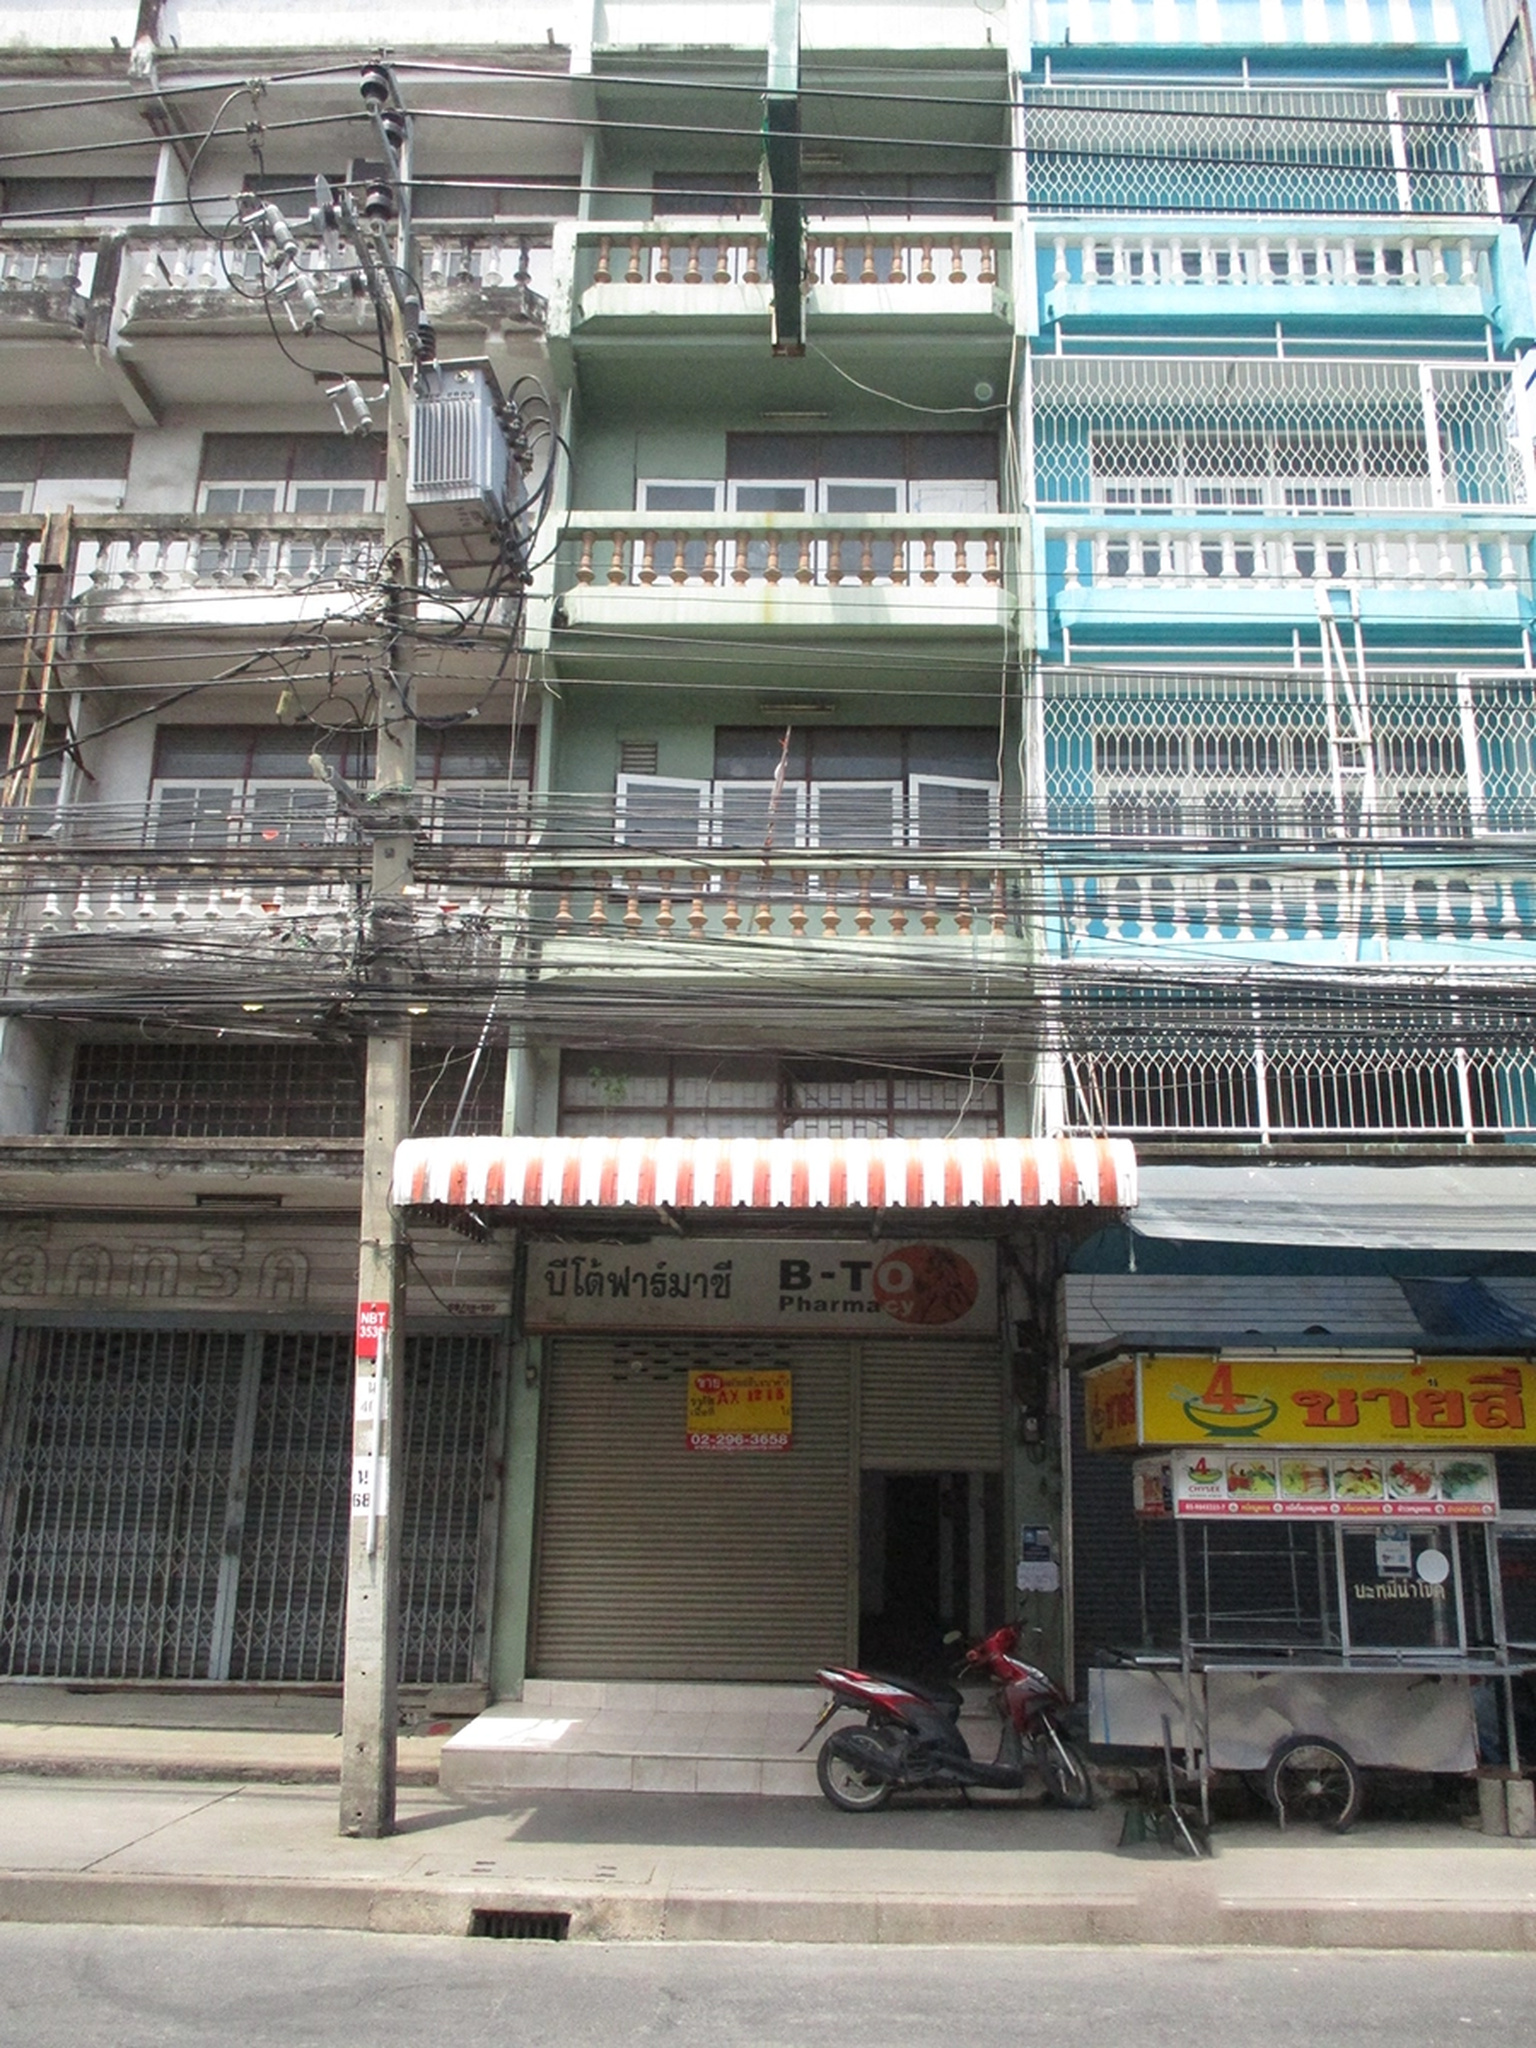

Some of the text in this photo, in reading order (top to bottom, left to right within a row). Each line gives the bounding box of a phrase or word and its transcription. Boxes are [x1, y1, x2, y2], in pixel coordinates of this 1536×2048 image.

[544, 1257, 733, 1300] บีโต้ฟาร์มาซี
[779, 1295, 915, 1315] Pharmacy
[361, 1311, 386, 1325] NBT
[690, 1433, 788, 1445] 02-296-3658
